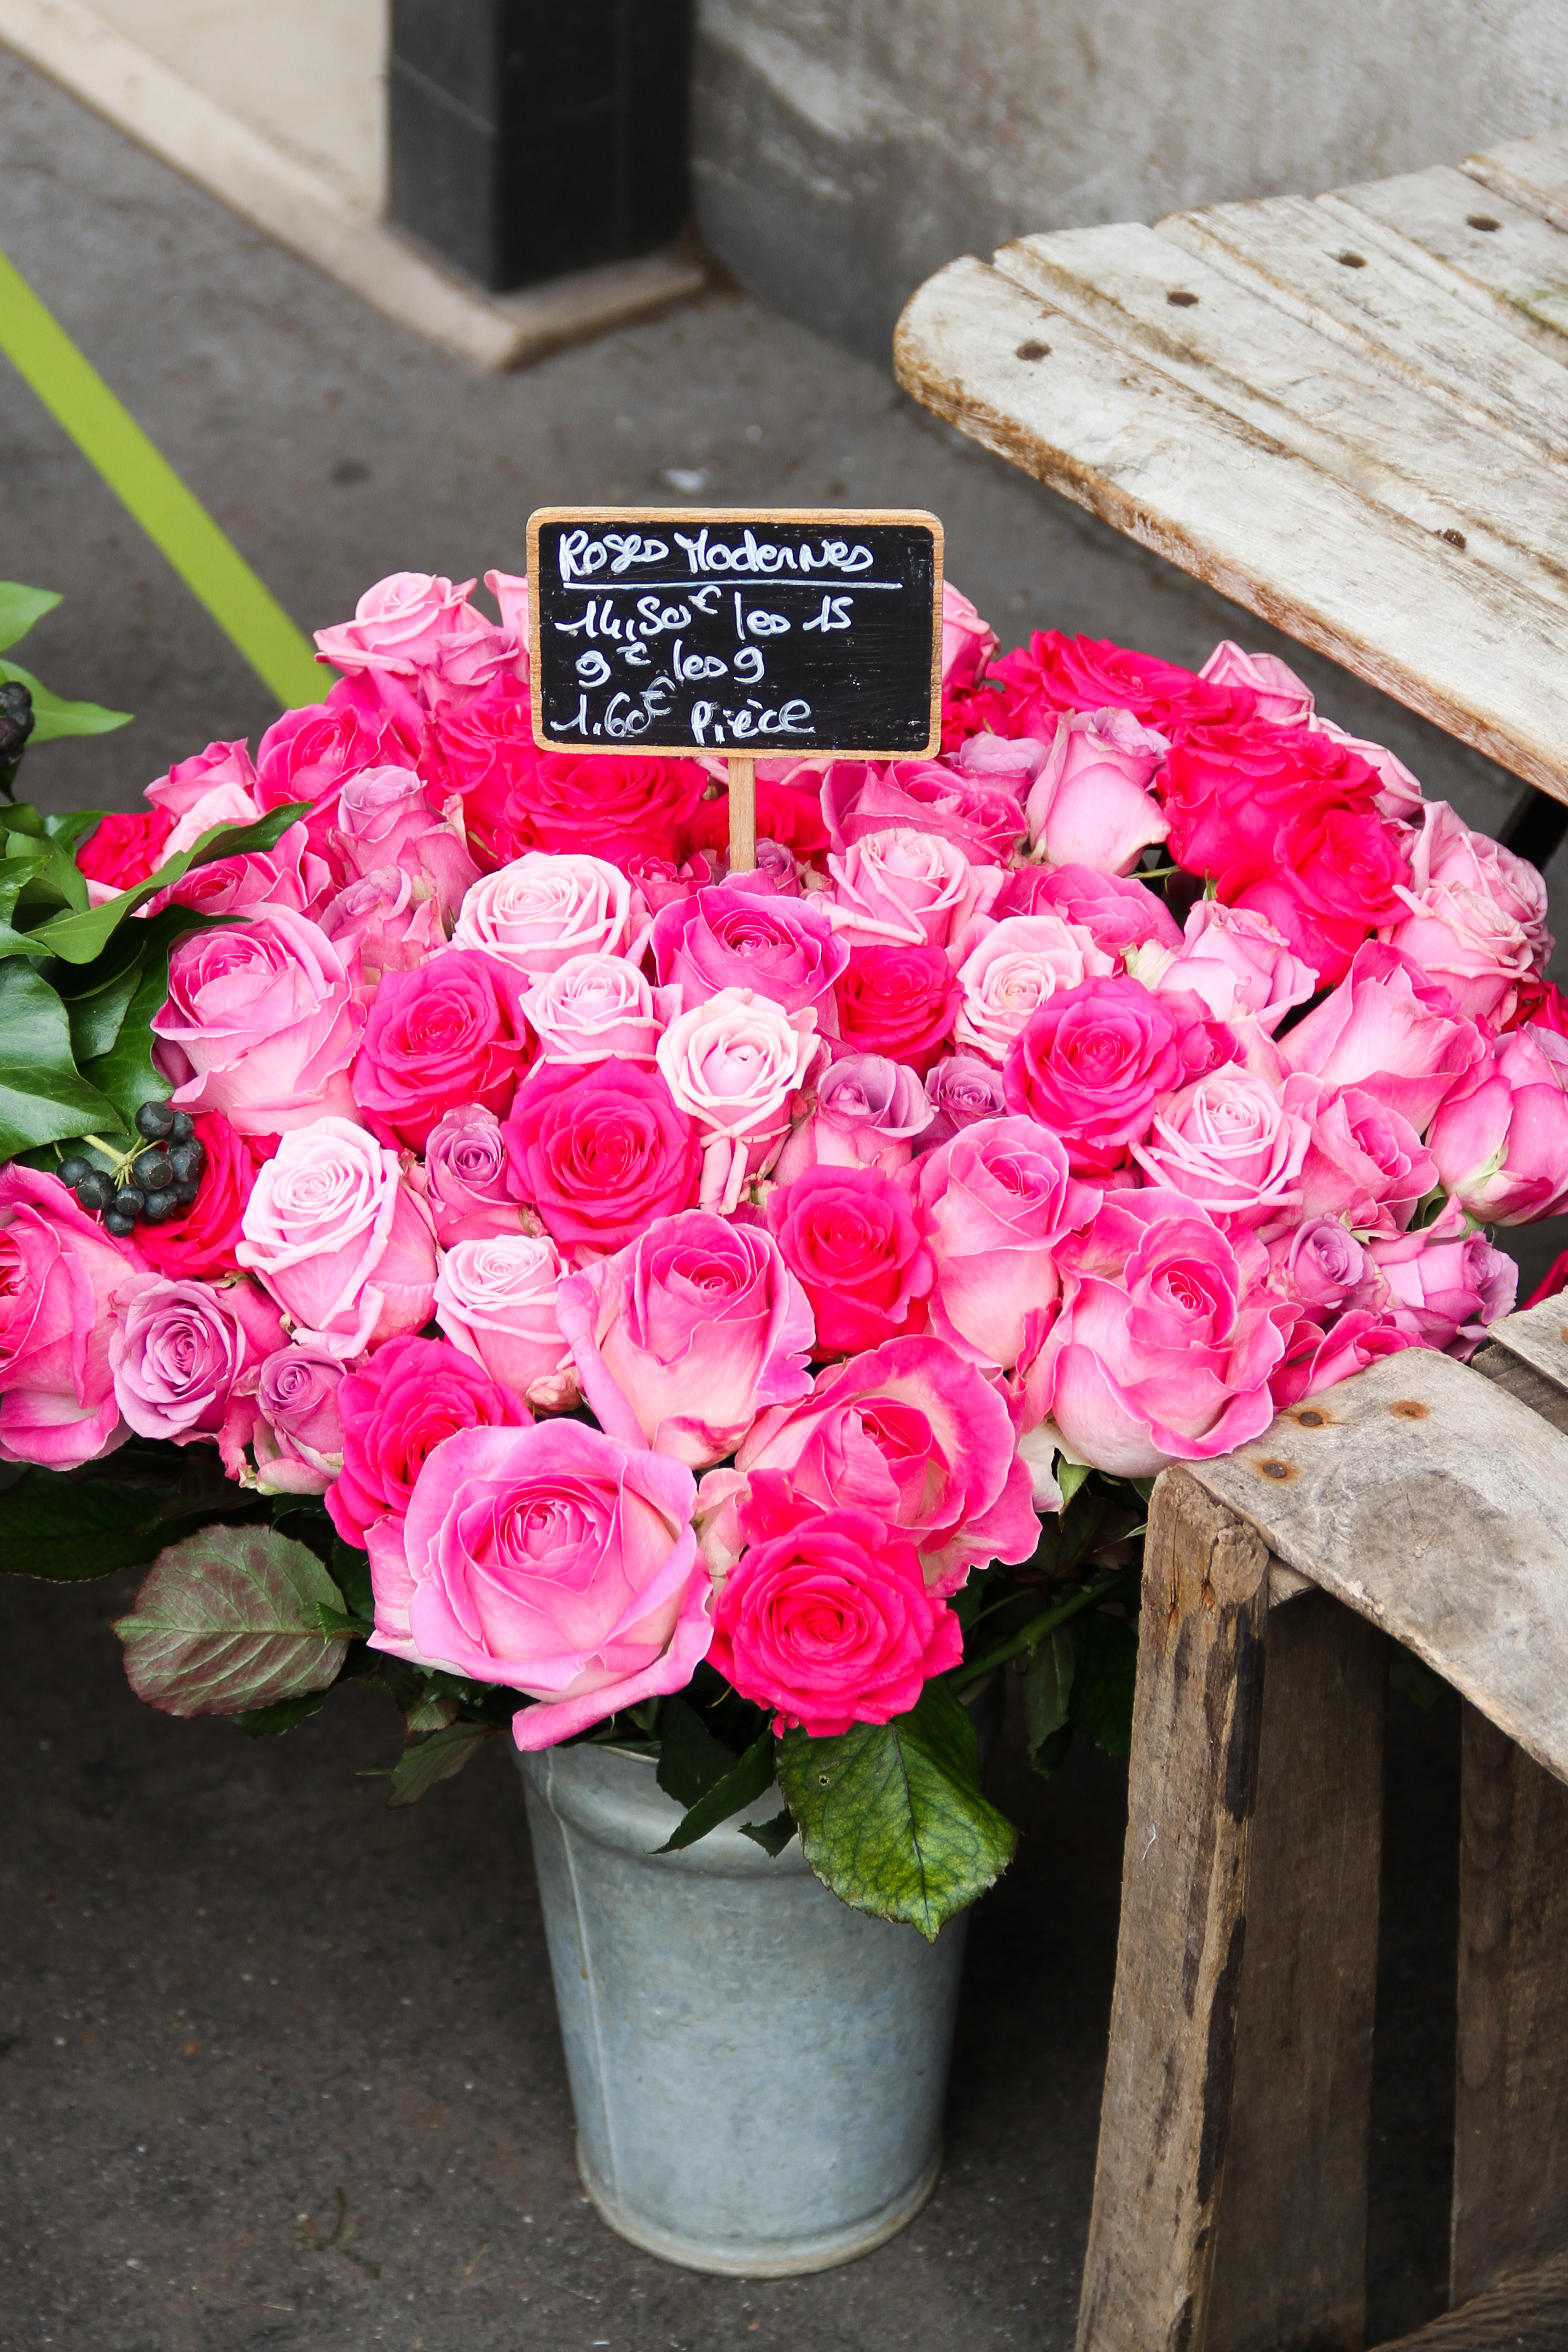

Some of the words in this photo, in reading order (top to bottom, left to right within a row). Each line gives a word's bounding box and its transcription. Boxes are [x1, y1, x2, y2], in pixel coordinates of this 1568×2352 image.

[560, 529, 669, 582] Roses
[734, 591, 792, 640] les
[802, 594, 855, 632] 15
[672, 638, 728, 683] les
[733, 646, 765, 684] 9
